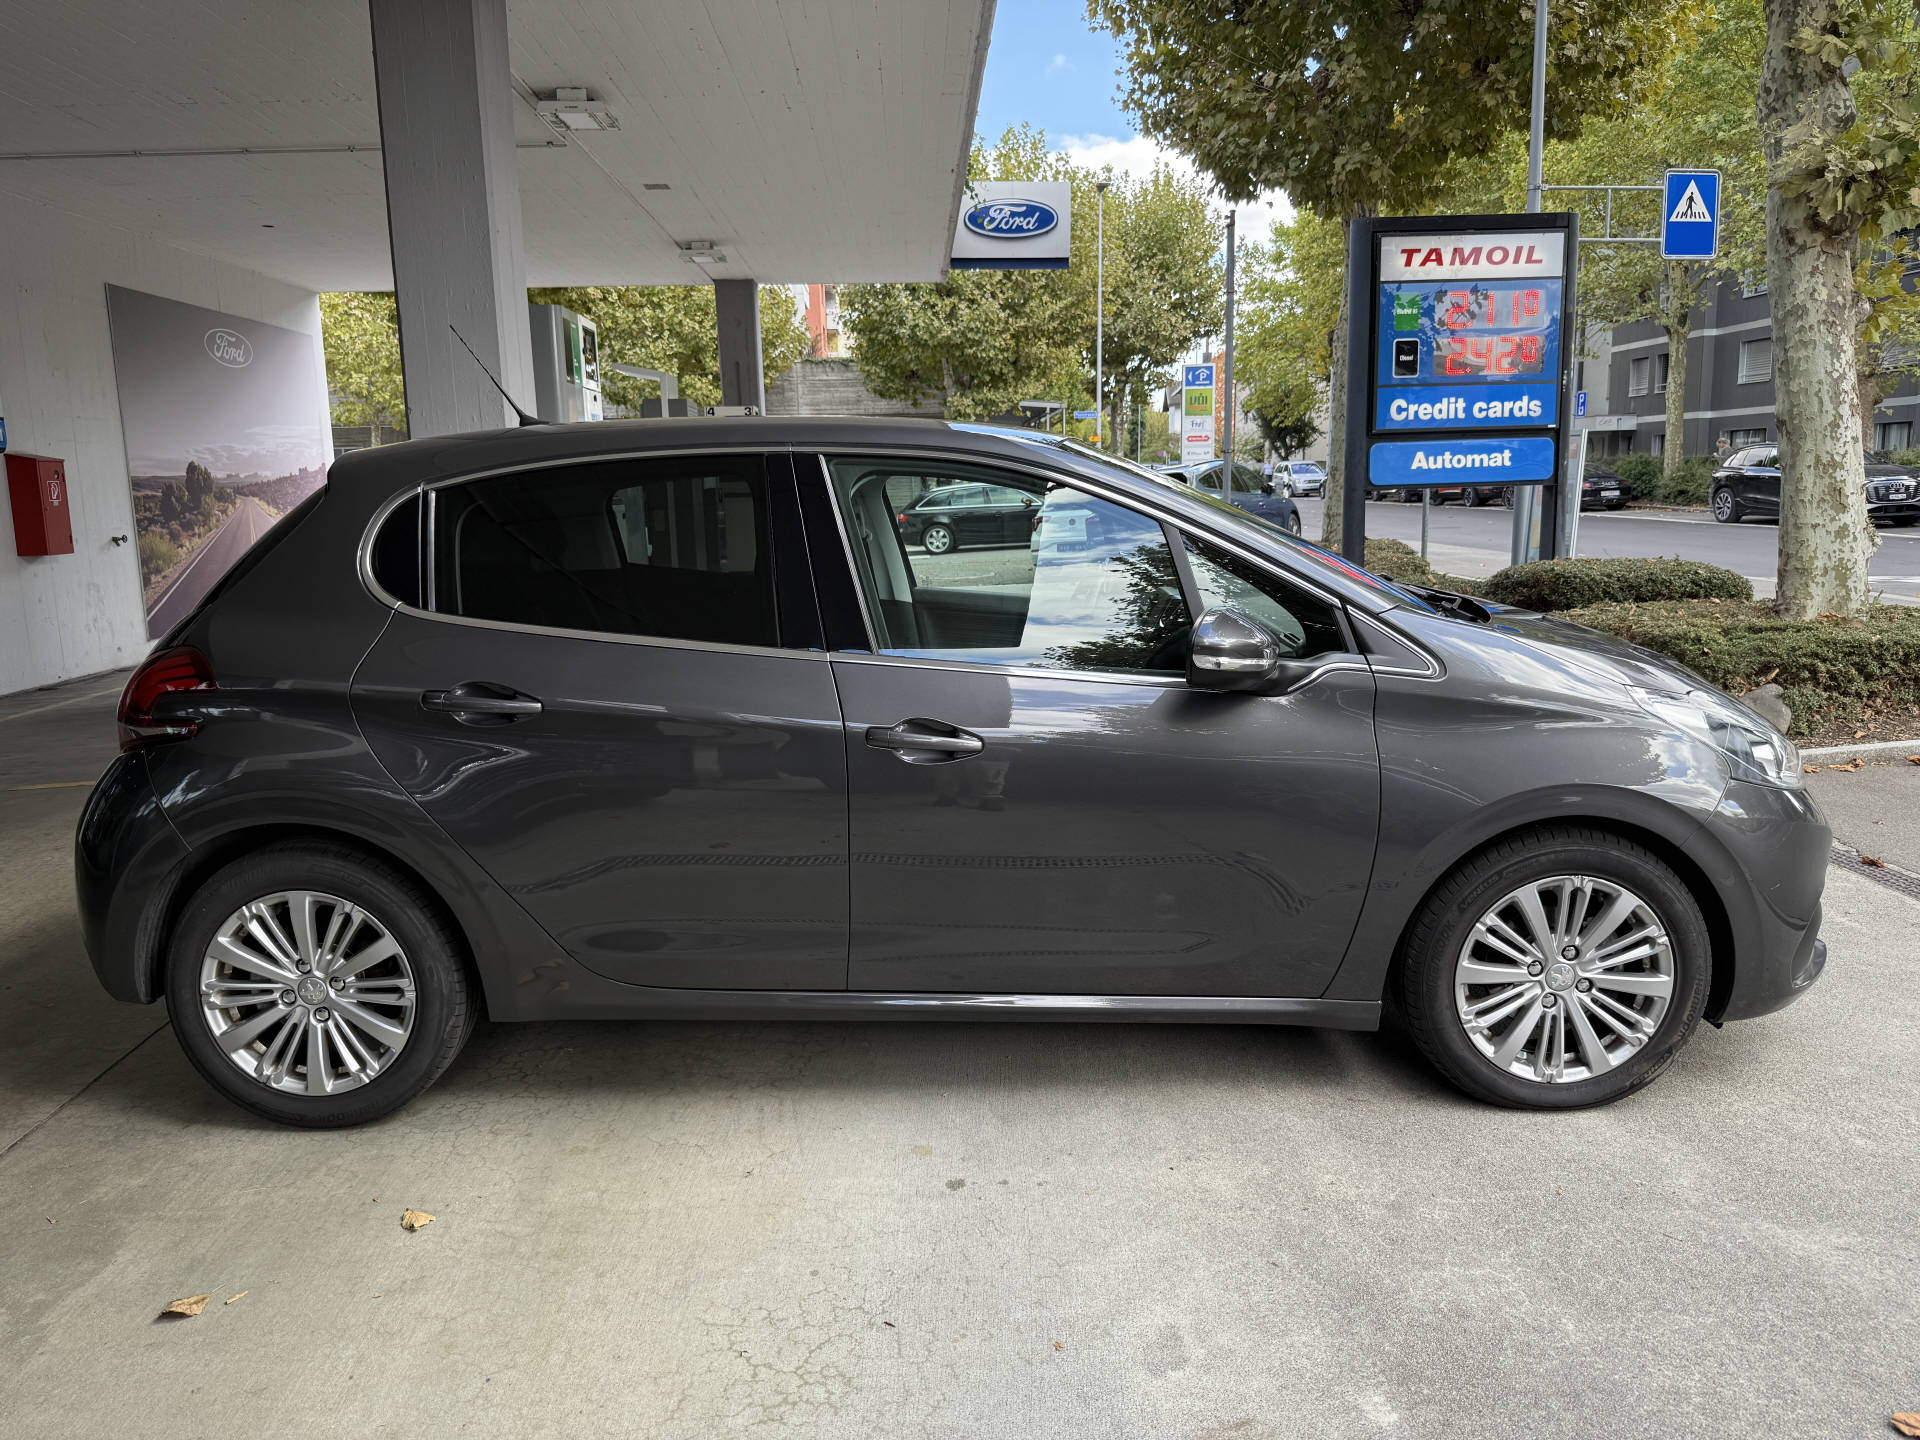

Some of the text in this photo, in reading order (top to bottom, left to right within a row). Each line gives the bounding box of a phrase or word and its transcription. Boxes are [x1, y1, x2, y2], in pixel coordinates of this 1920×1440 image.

[984, 204, 1040, 230] Ford
[1400, 245, 1543, 268] TAMOIL
[214, 333, 246, 362] Ford
[707, 407, 715, 416] 4
[744, 406, 752, 416] 3
[1389, 395, 1542, 422] Credit cards
[1410, 449, 1512, 470] Automat
